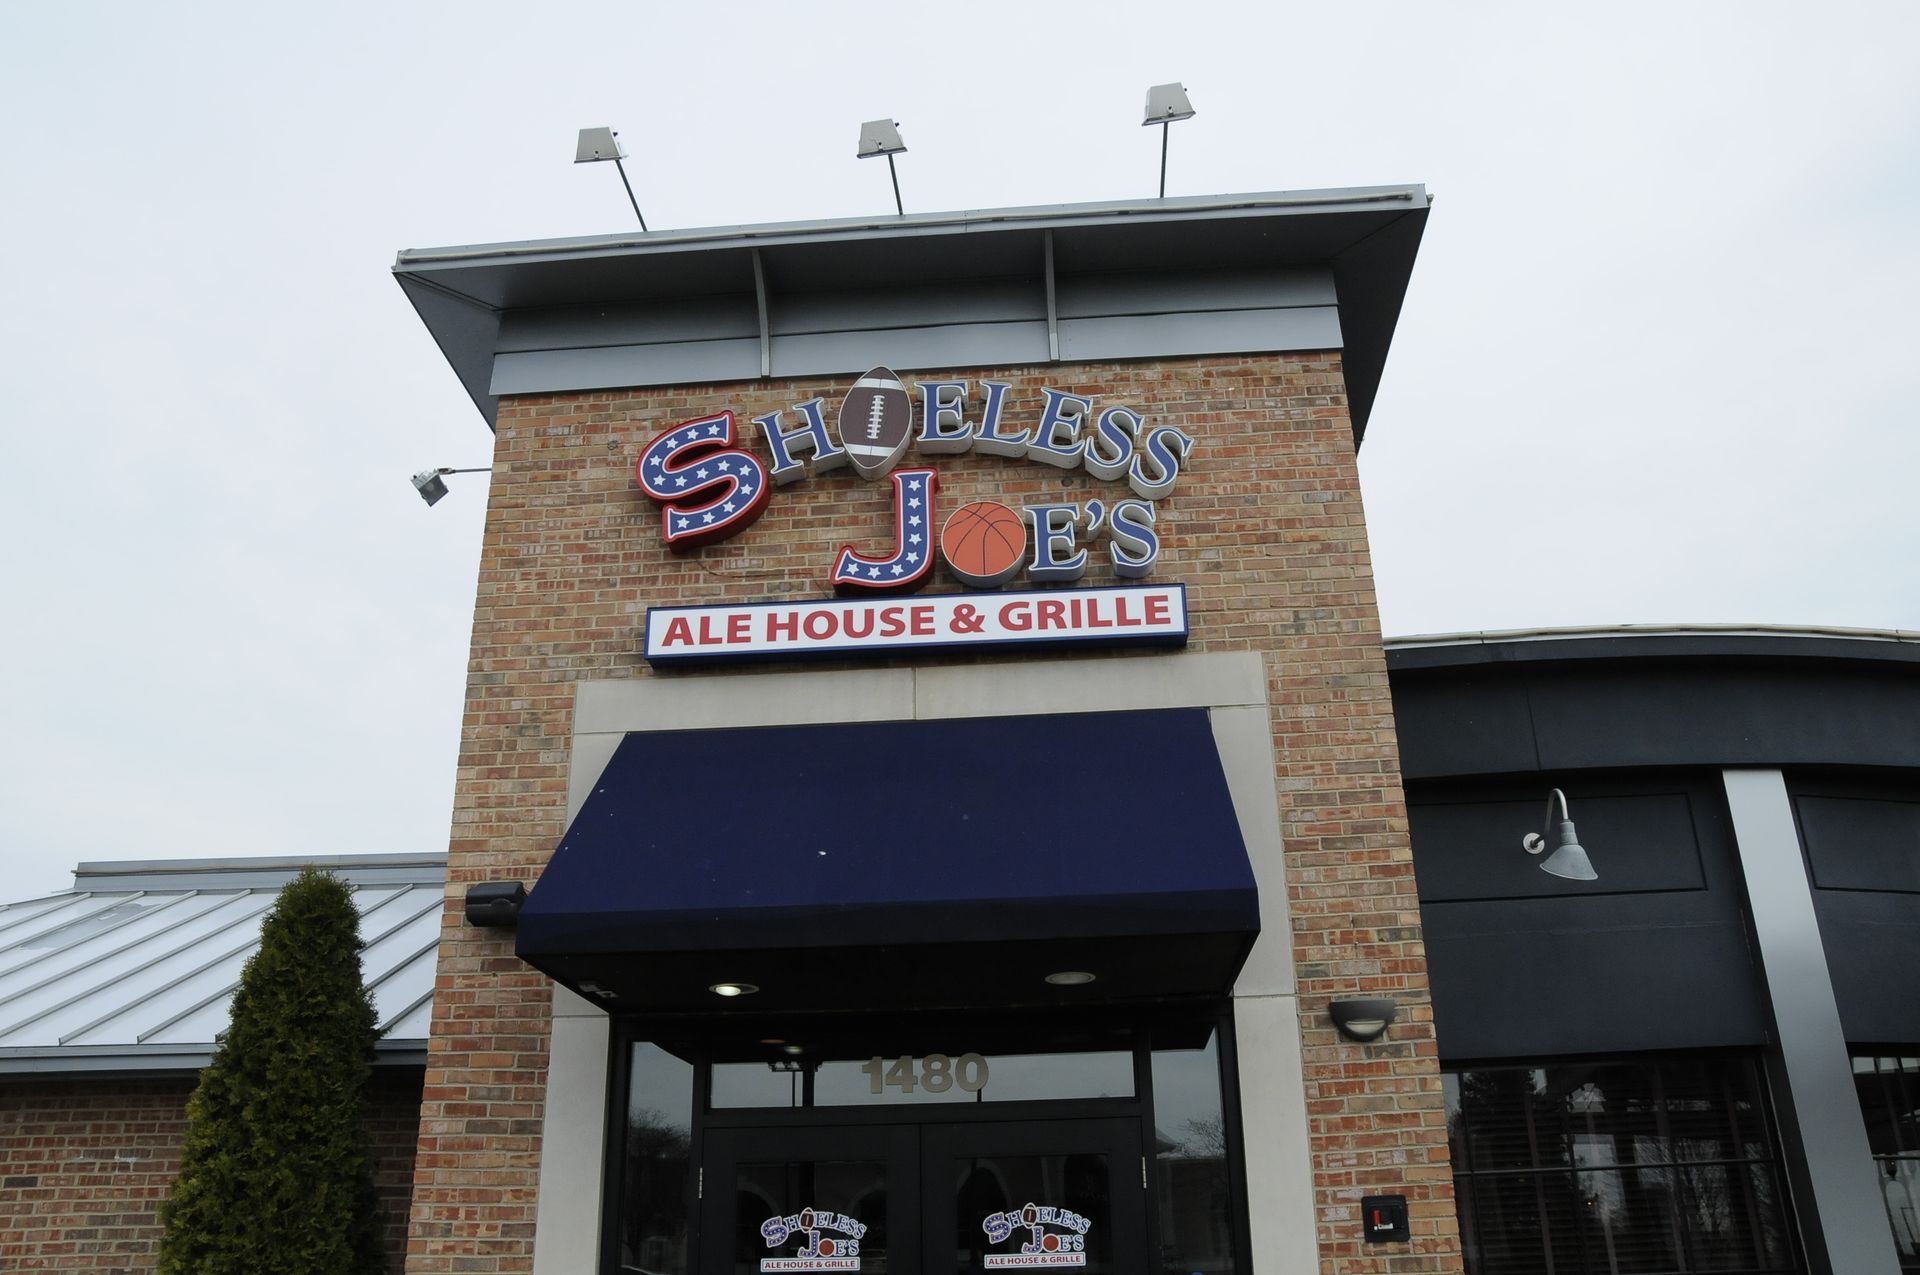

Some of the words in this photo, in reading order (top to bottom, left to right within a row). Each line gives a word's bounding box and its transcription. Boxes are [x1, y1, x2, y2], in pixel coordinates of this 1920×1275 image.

[661, 615, 752, 648] ALE
[766, 604, 936, 643] HOUSE
[948, 604, 985, 635] &
[998, 594, 1172, 632] GRILLE
[862, 1052, 989, 1095] 1480
[764, 1262, 782, 1270] ALE
[783, 1261, 813, 1269] HOUSE
[816, 1260, 823, 1268] &
[1007, 1257, 1039, 1265] HOUSE
[1049, 1255, 1081, 1263] GRILLE
